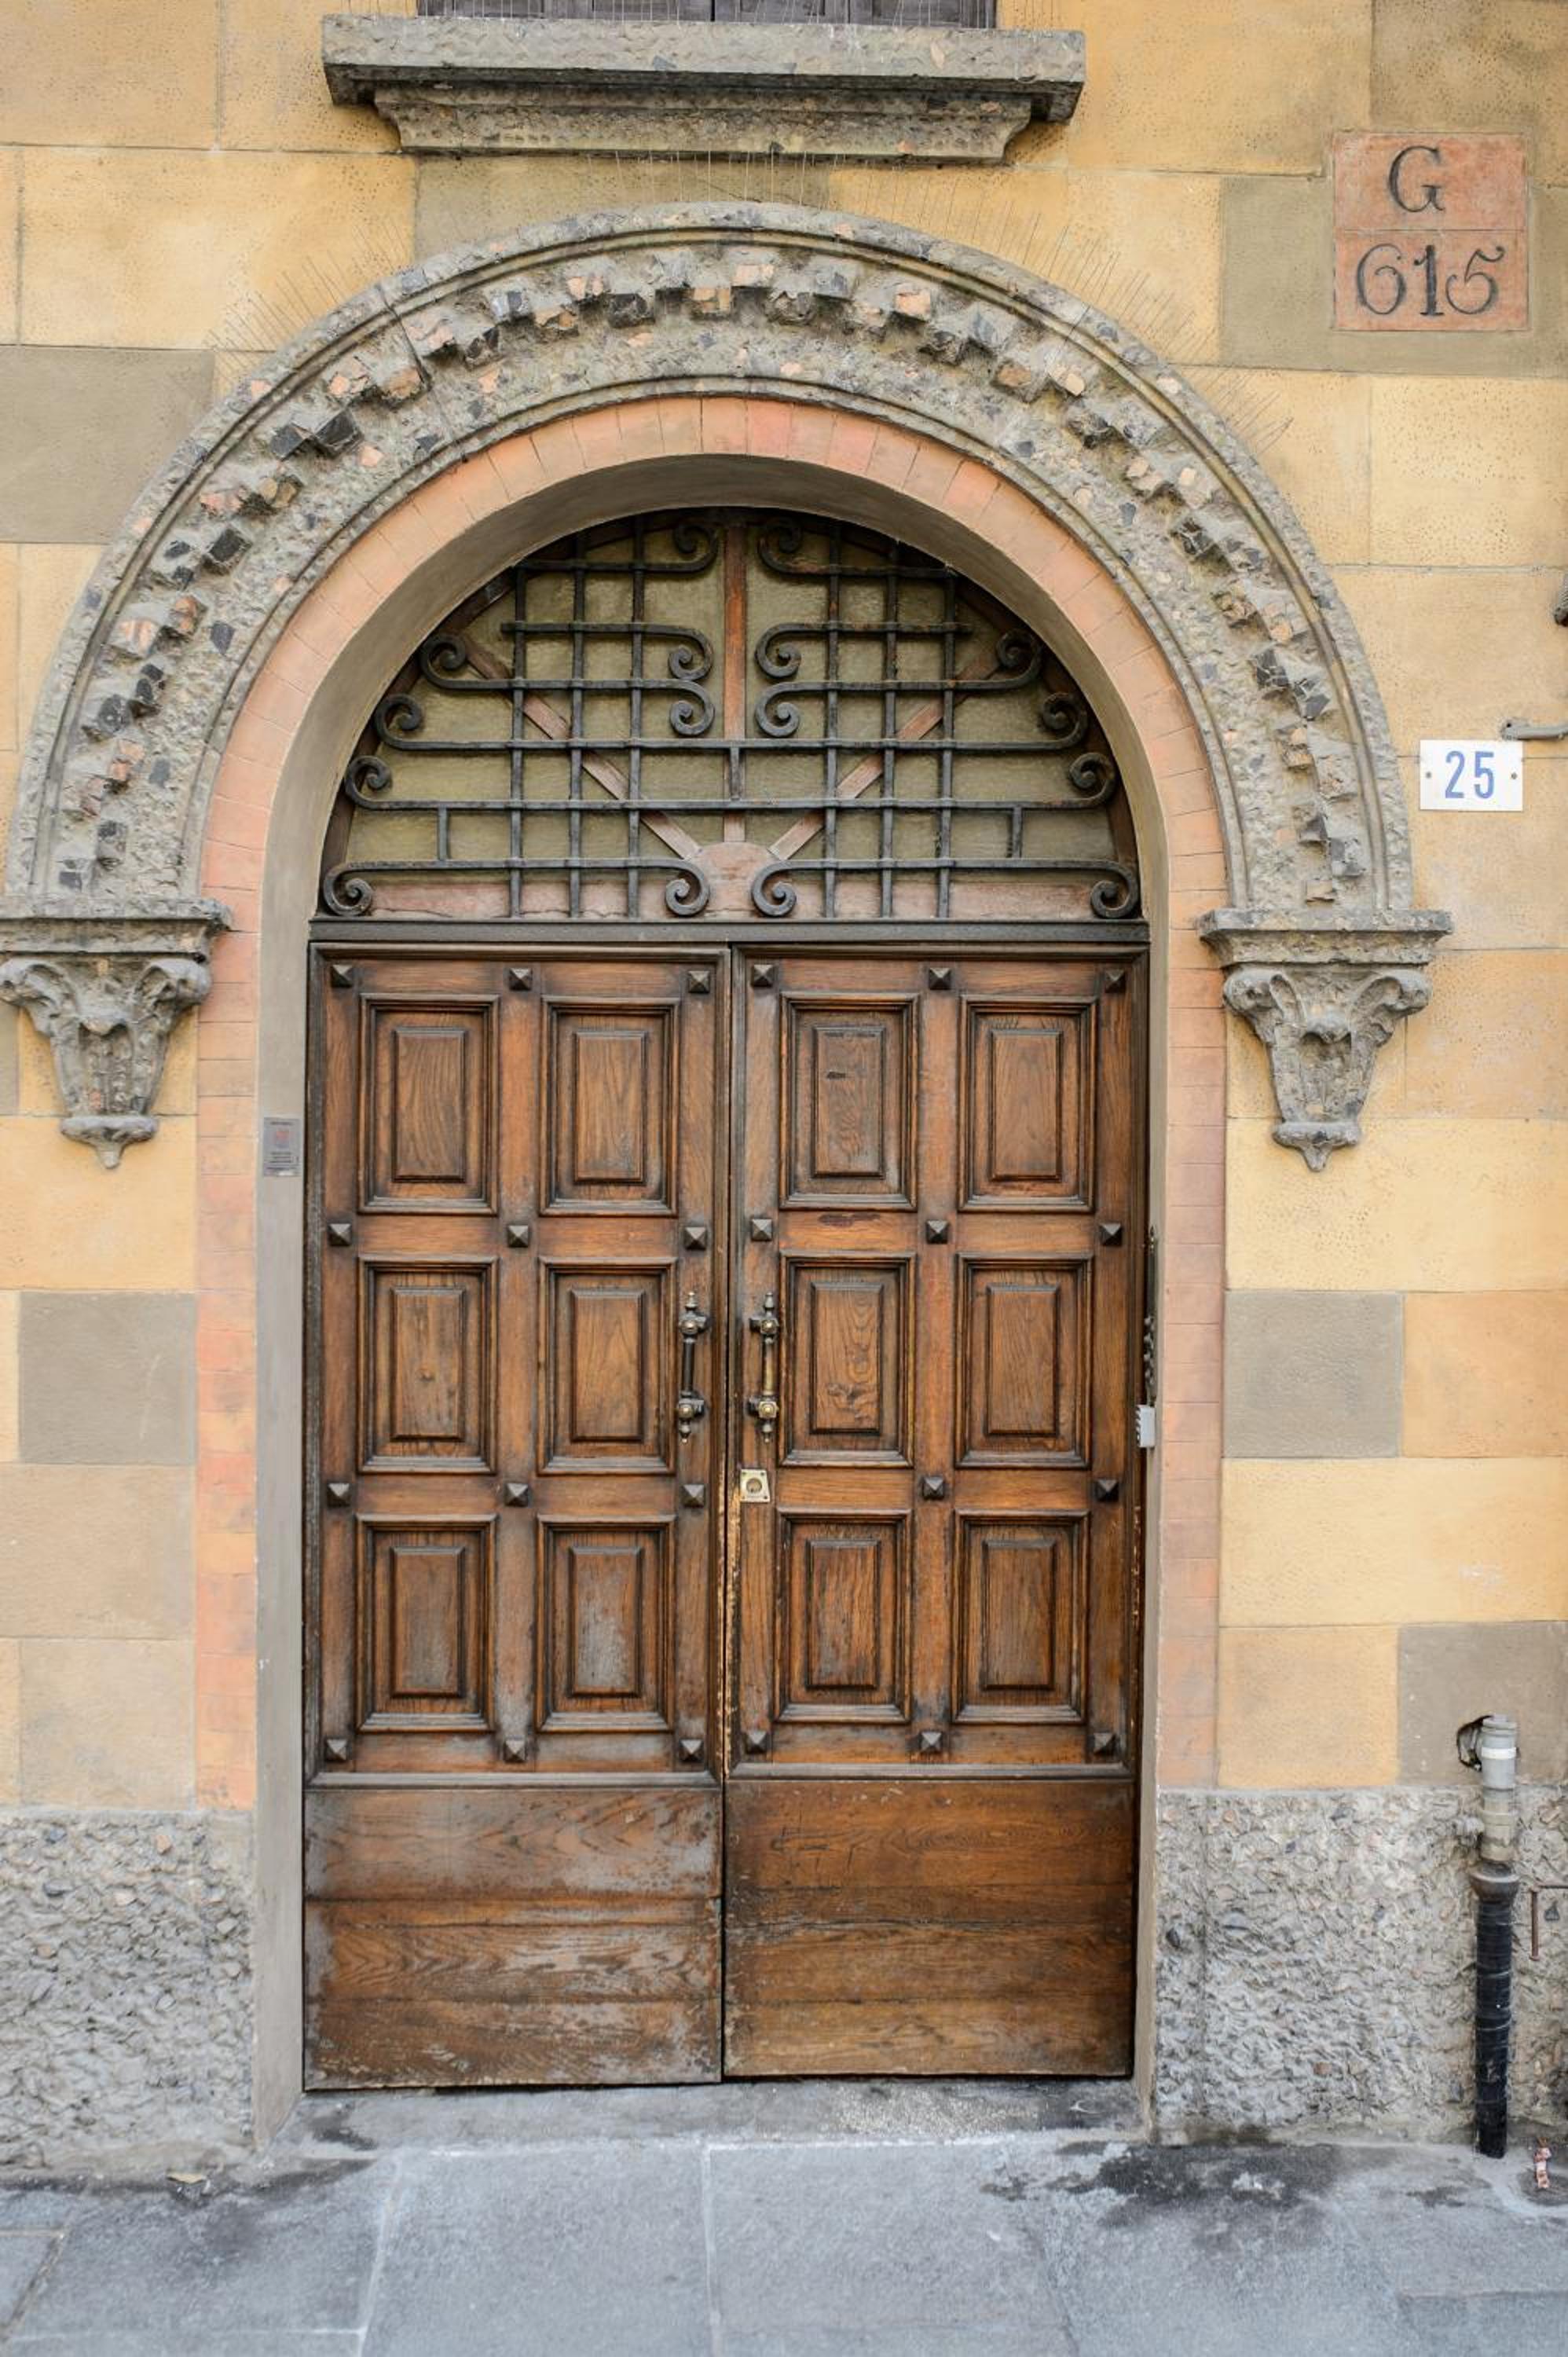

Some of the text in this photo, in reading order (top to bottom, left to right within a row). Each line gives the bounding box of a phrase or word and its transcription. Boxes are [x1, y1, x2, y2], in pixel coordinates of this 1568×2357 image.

[1387, 145, 1446, 213] G
[1356, 244, 1506, 317] 615
[1445, 750, 1495, 799] 25
